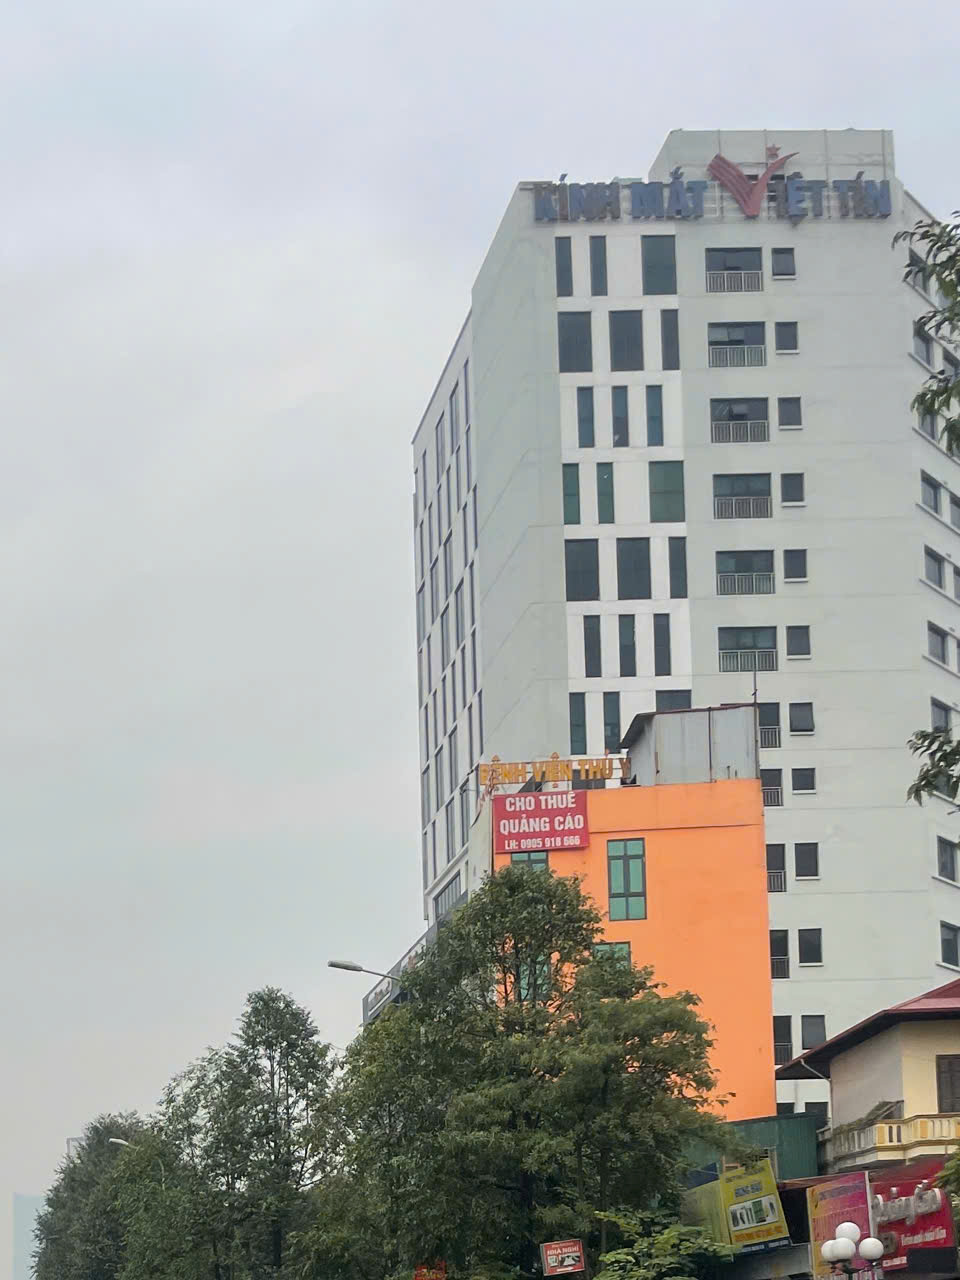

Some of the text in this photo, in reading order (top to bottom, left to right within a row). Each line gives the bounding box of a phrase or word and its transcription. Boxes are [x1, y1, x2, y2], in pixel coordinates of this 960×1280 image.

[532, 752, 572, 788] VIỆN
[578, 749, 613, 781] THÚ
[505, 791, 577, 811] CHO THUÊ
[500, 813, 584, 835] QUẢNG CÁO
[505, 839, 519, 850] LH:
